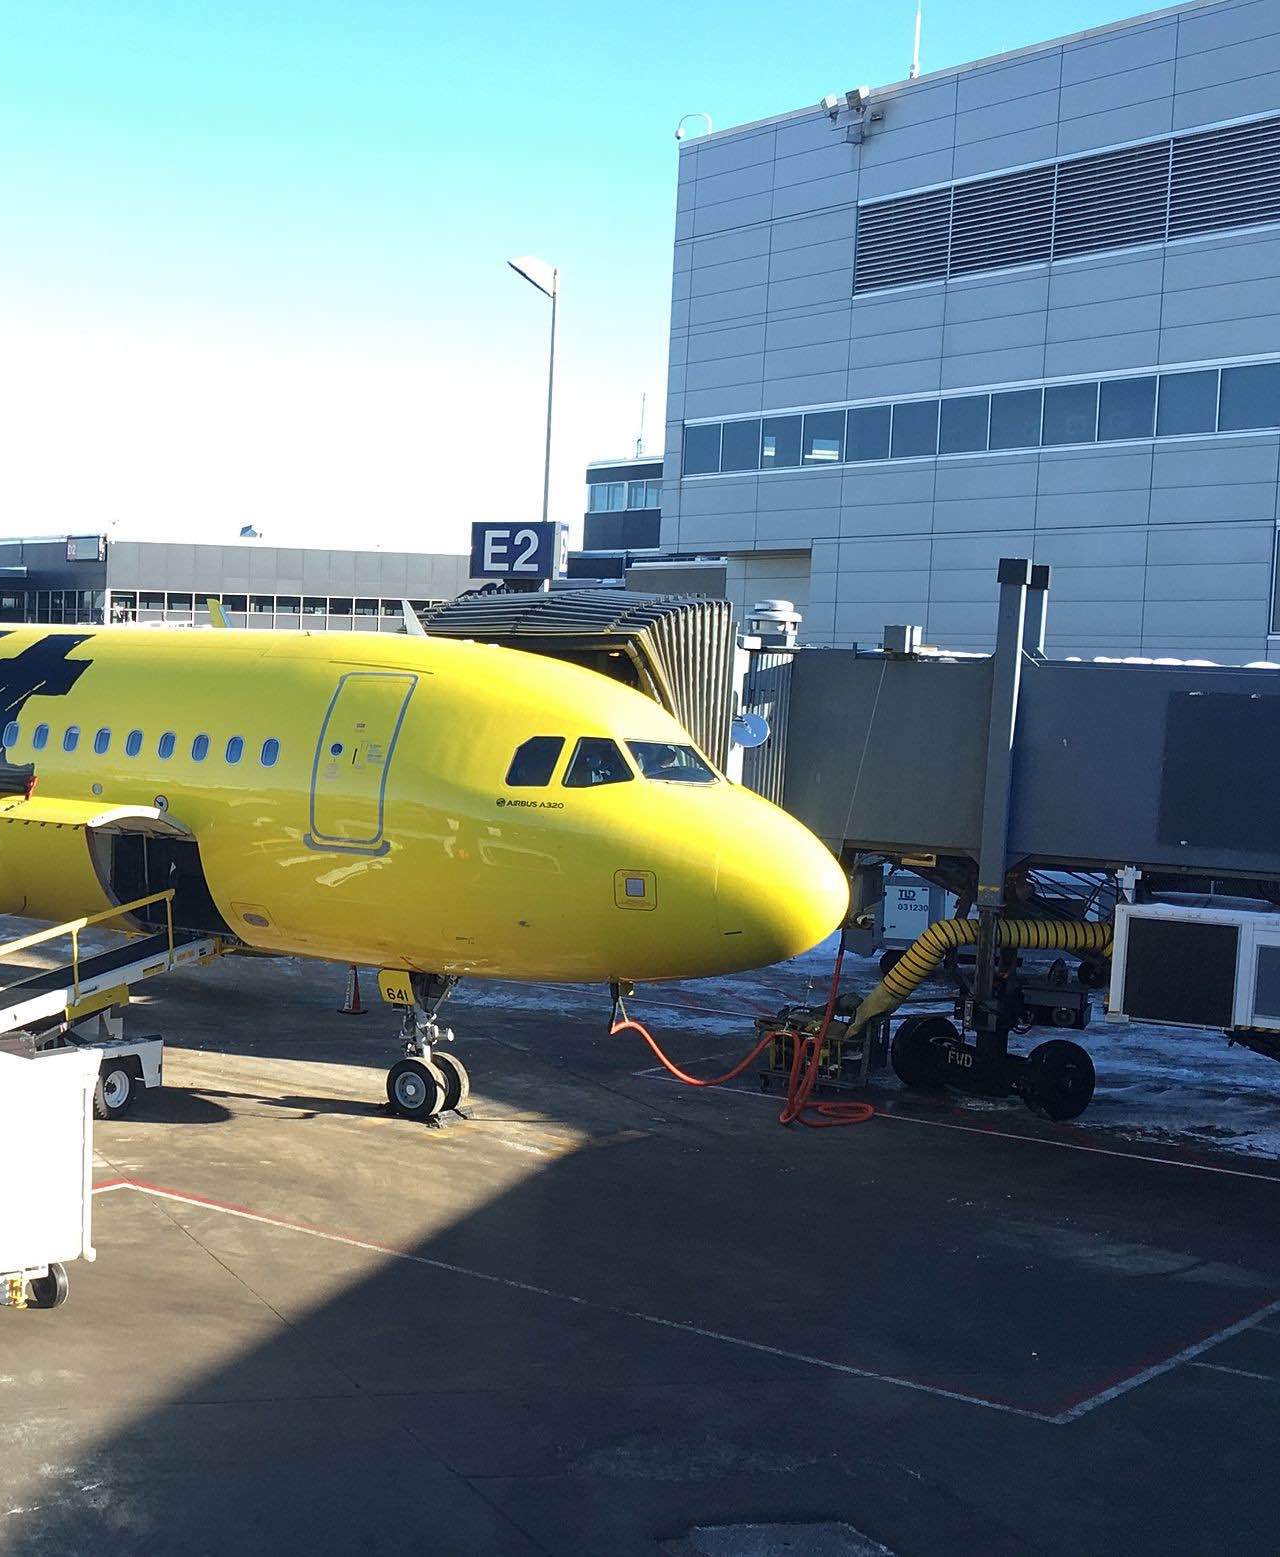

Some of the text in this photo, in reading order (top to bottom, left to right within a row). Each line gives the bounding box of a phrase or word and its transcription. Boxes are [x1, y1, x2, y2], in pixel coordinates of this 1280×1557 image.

[483, 529, 539, 572] E2
[506, 800, 565, 809] AIRBUS A320
[386, 987, 409, 1001] 641
[948, 1050, 973, 1068] FWD
